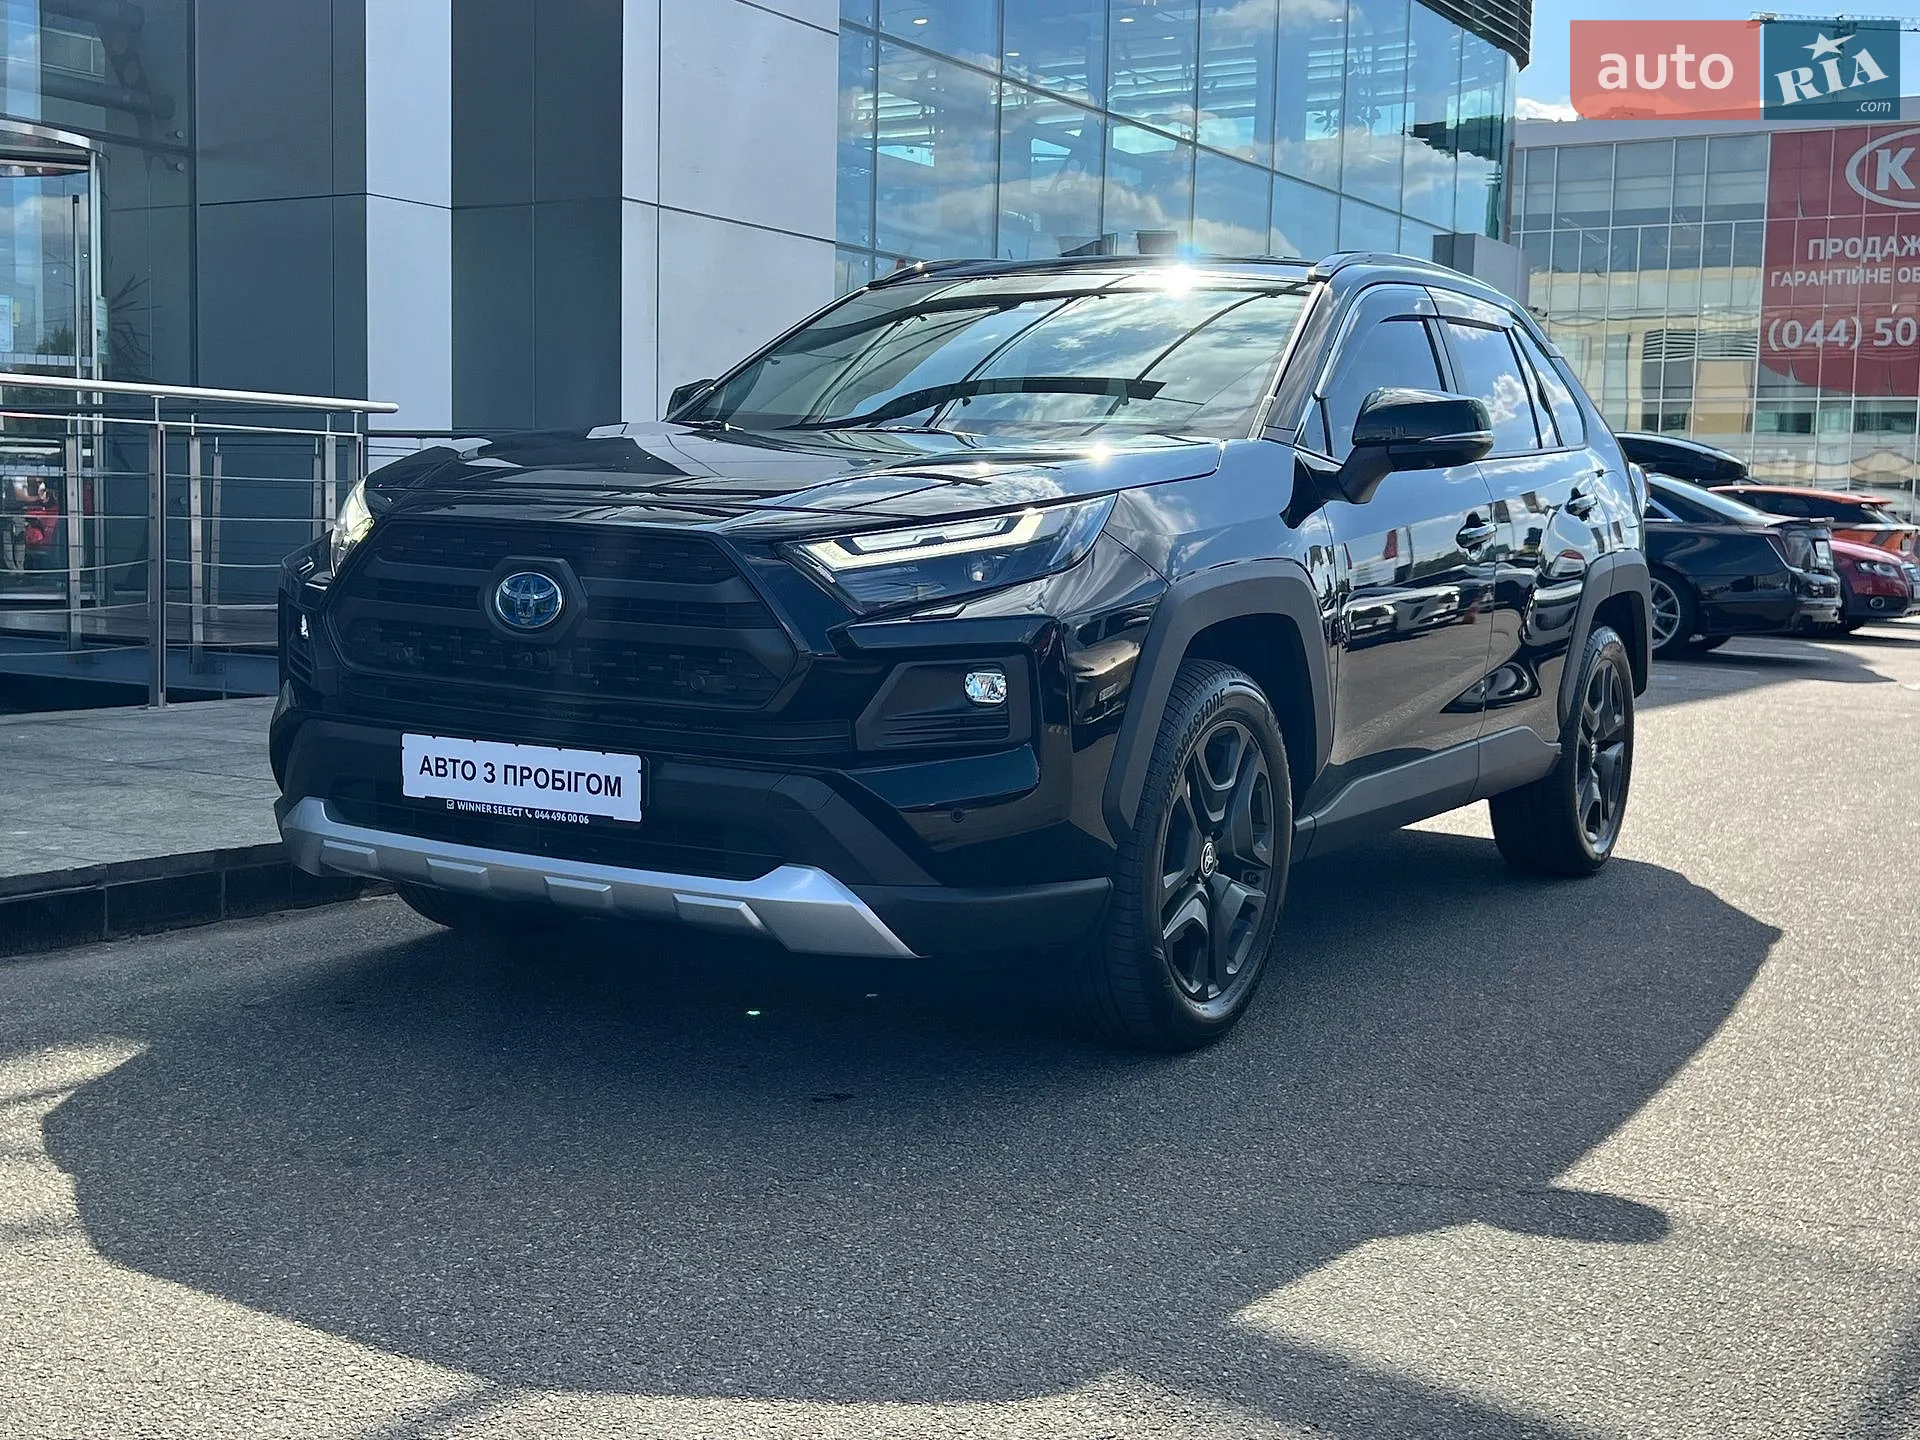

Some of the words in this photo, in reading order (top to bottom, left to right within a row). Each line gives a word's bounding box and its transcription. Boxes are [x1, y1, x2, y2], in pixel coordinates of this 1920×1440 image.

[1807, 234, 1920, 264] ПРОДАЖ
[1770, 265, 1892, 288] ГАРАНТІЙНЕ
[1767, 316, 1863, 352] (044)
[418, 755, 477, 782] АВТО
[503, 764, 622, 798] ПРОБІГОМ
[457, 800, 492, 814] WINNER
[493, 804, 523, 817] SELECT
[534, 809, 551, 820] 044
[551, 811, 567, 822] 496
[567, 813, 578, 823] 00
[578, 814, 590, 825] 06
